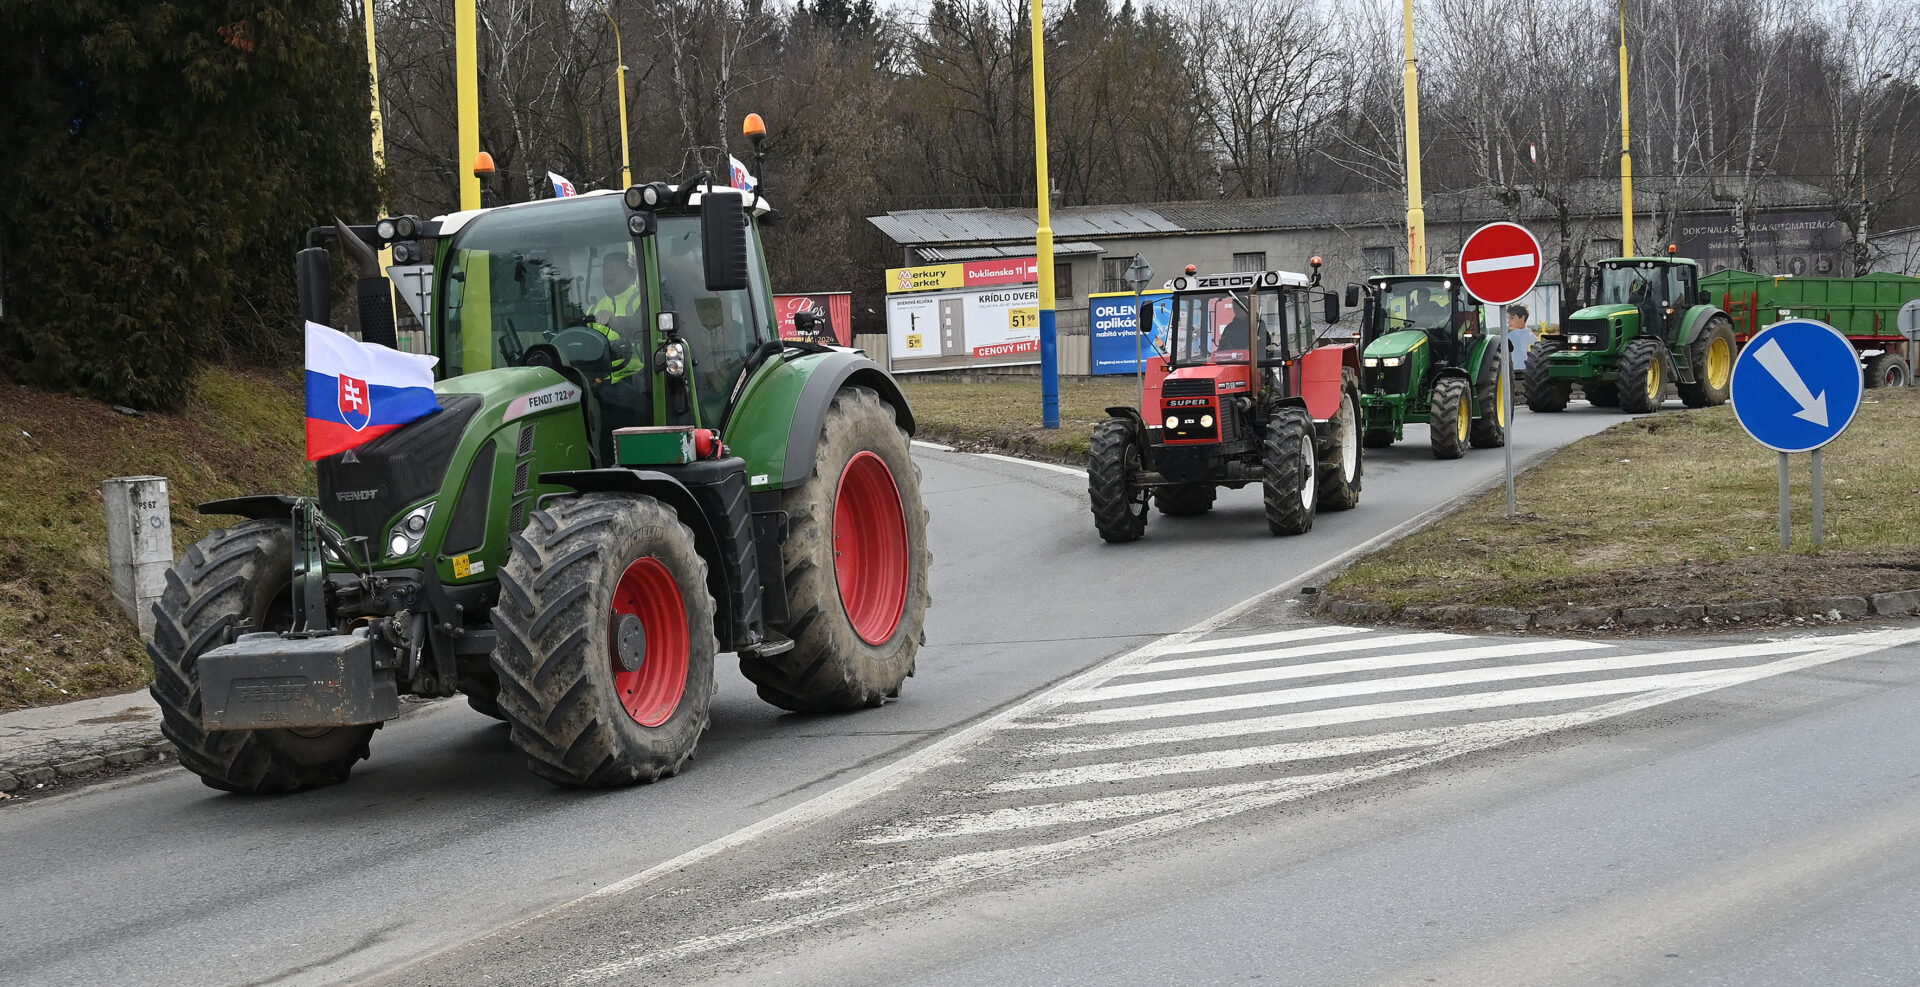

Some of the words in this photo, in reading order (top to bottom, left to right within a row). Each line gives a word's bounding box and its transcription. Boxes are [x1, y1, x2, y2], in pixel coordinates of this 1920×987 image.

[898, 270, 946, 280] Merkury
[969, 268, 1014, 279] Duklianska
[1015, 267, 1023, 275] 11
[899, 279, 940, 290] Market
[1198, 276, 1254, 288] ZETOR
[979, 293, 1011, 303] KRÍDLO
[787, 297, 826, 317] Ples
[1096, 305, 1137, 317] ORLEN
[1012, 315, 1025, 328] 51
[978, 342, 1014, 356] CENOVÝ
[528, 393, 553, 408] FENDT
[554, 390, 568, 402] 722
[336, 489, 379, 501] FENDT
[138, 501, 147, 509] PS
[148, 500, 157, 509] 62
[235, 683, 308, 703] FENDT
